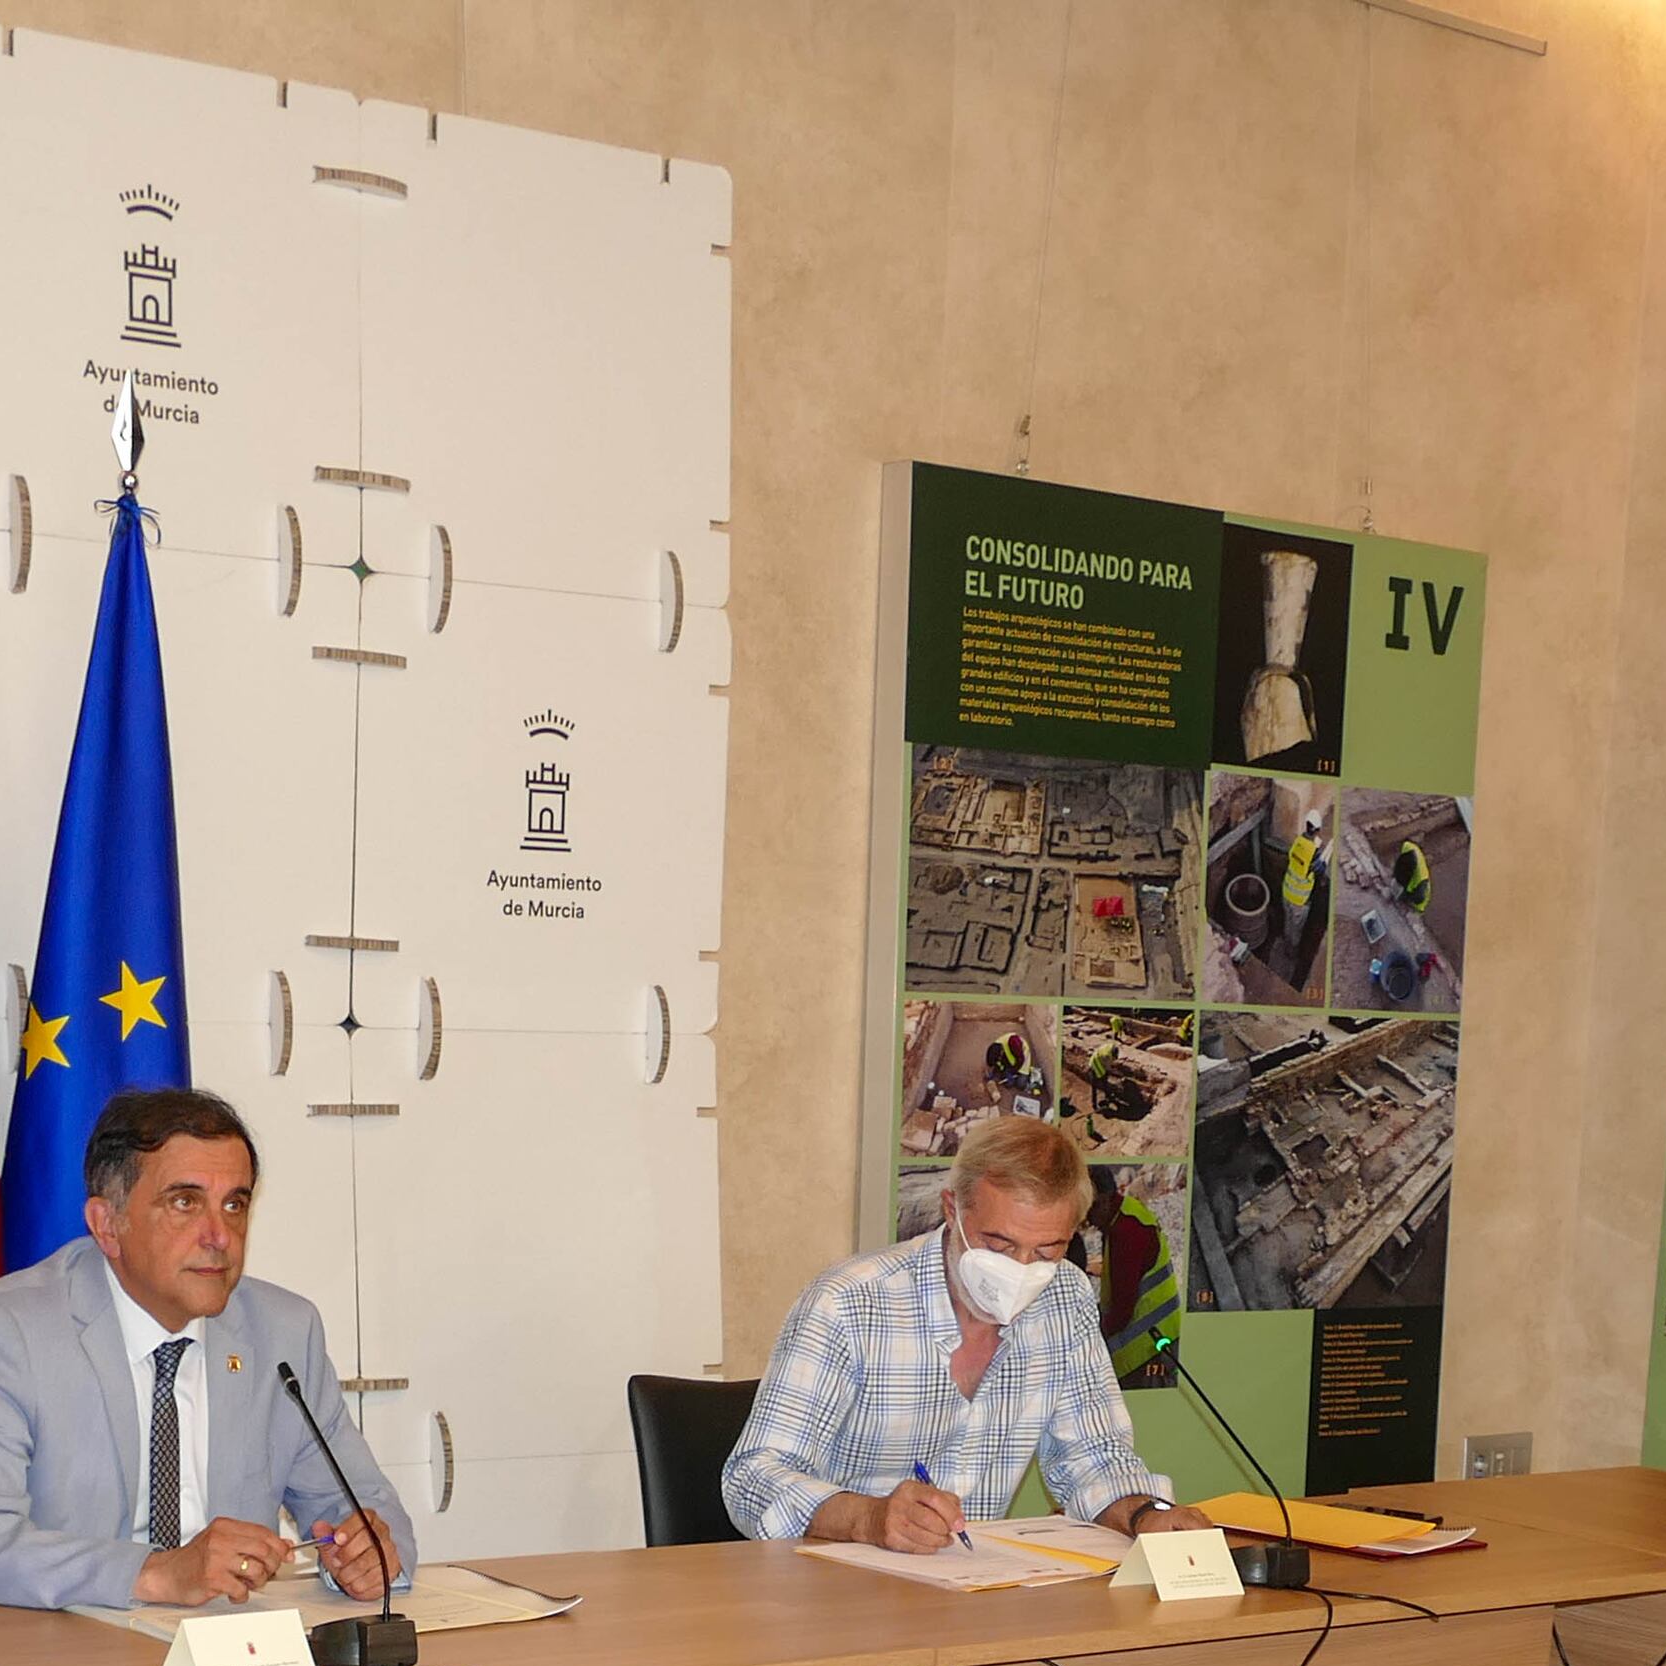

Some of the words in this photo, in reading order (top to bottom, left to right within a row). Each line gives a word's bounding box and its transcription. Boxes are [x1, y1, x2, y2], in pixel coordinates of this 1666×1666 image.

[103, 394, 118, 413] d
[965, 534, 1134, 583] CONSOLIDANDO
[1139, 560, 1193, 591] PARA
[965, 570, 991, 597] EL
[998, 574, 1084, 610] FUTURO
[963, 606, 978, 617] Los
[1385, 575, 1464, 656] IV
[960, 683, 974, 692] con
[486, 869, 602, 892] Ayuntamiento
[503, 899, 523, 916] de
[528, 900, 584, 919] Murcia
